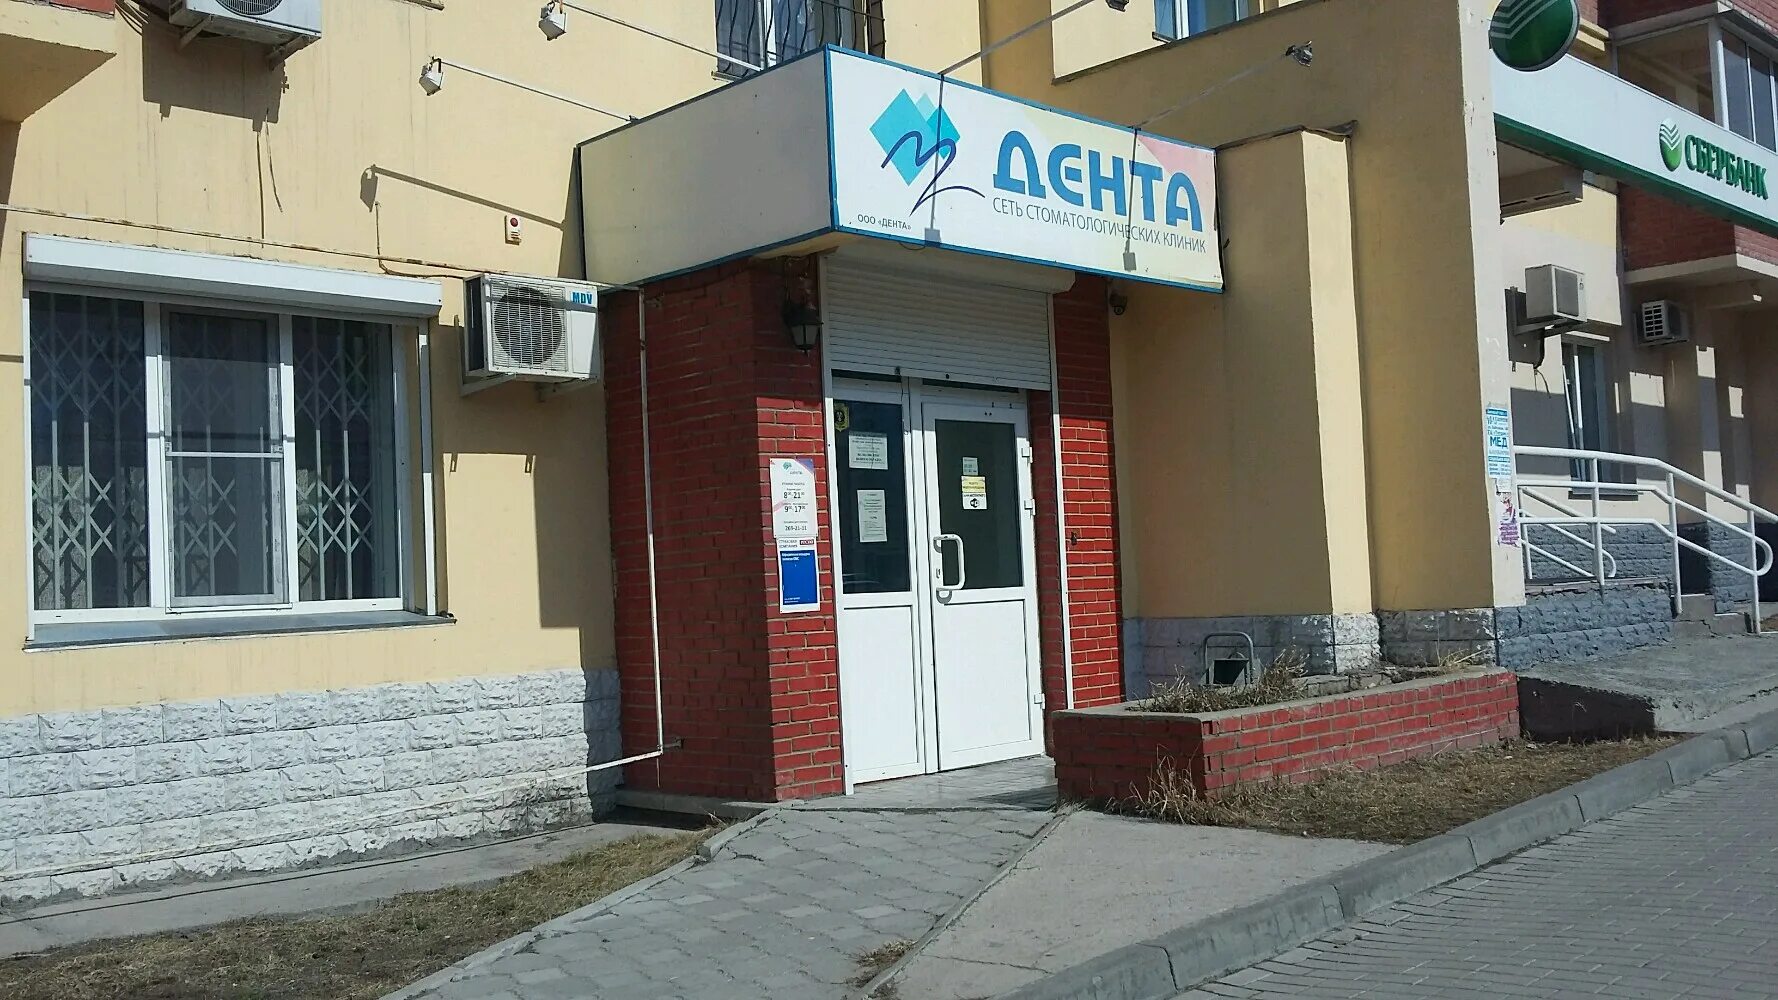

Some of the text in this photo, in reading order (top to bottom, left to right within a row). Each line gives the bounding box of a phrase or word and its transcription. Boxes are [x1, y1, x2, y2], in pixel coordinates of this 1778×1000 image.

[1684, 134, 1769, 200] СБЕРБАНК
[857, 213, 912, 231] ООО «ДЕНТА»
[992, 197, 1207, 254] СЕТЬ СТОМАТОЛОГИЧЕСКИХ КЛИНИК
[572, 291, 593, 305] MDV
